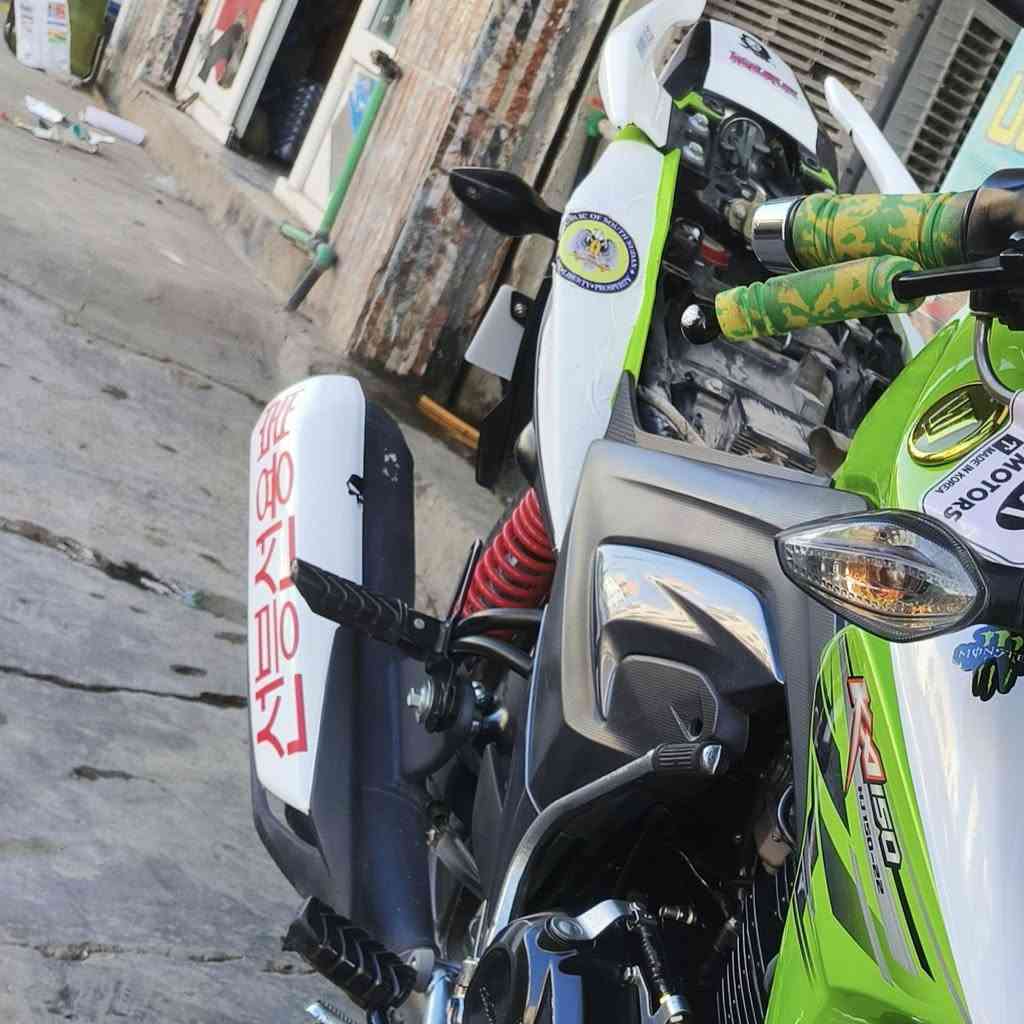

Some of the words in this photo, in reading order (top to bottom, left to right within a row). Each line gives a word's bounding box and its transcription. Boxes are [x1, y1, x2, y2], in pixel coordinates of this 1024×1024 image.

[973, 448, 999, 467] MADE
[961, 465, 975, 476] IN
[935, 469, 964, 494] KOREA
